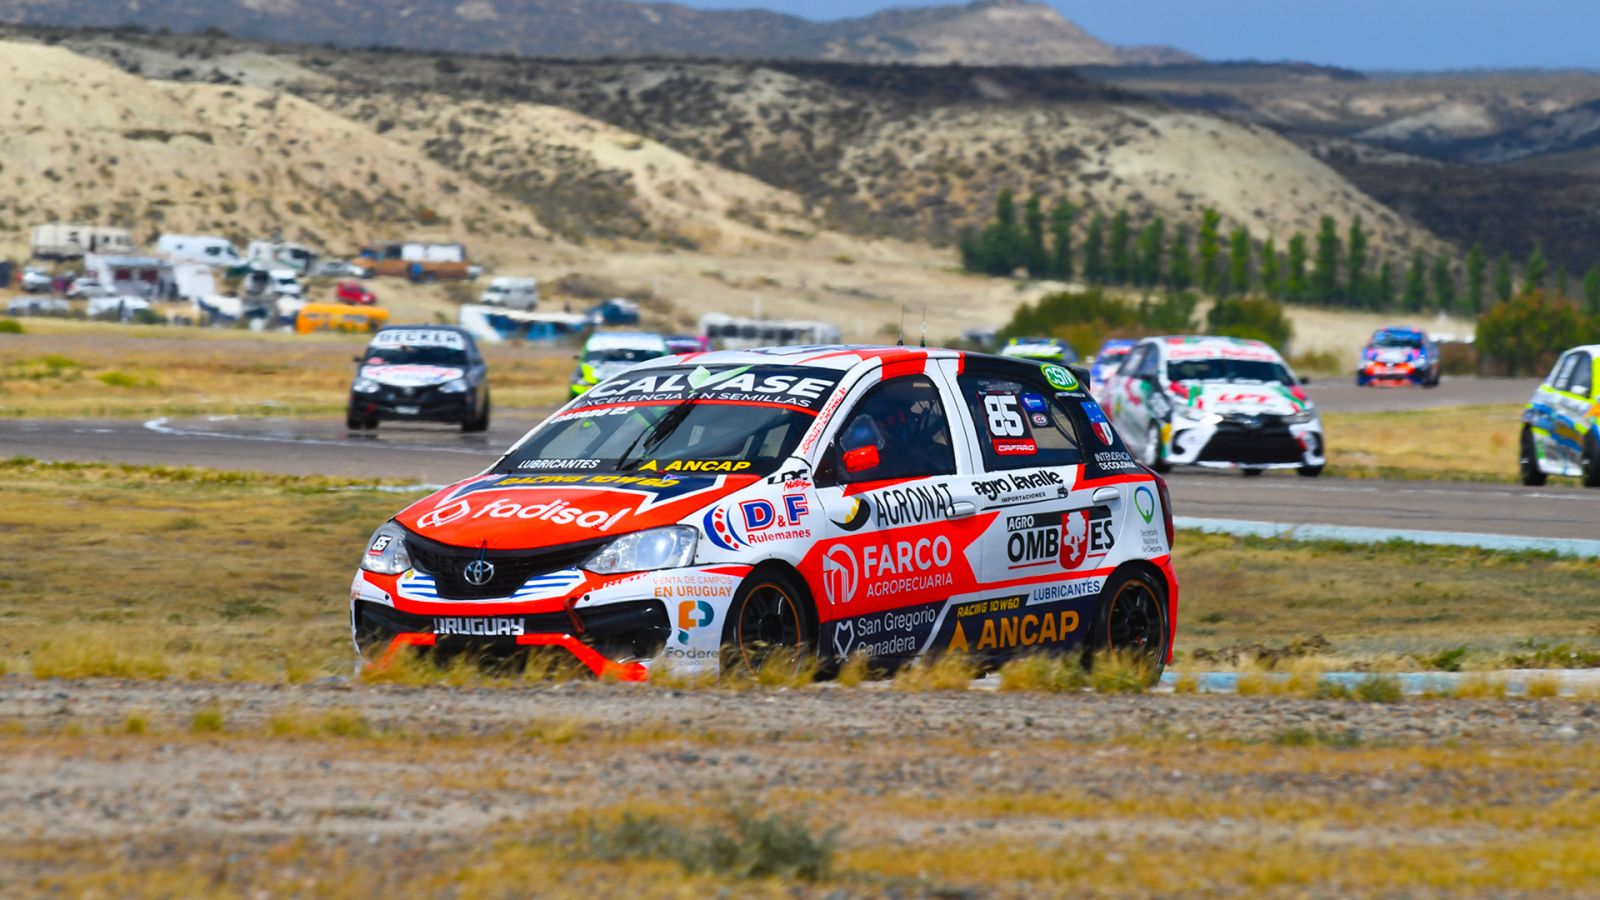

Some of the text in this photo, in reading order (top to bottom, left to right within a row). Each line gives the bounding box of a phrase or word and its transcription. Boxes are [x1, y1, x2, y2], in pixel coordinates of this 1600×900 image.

[588, 365, 834, 399] CALVASE
[1044, 366, 1078, 386] CSM
[719, 392, 811, 408] SEMILLAS
[984, 395, 1025, 437] 85
[518, 459, 601, 469] LUBRICANTES
[664, 460, 751, 473] ANCAP
[971, 470, 1064, 501] agro lavalle
[873, 483, 957, 527] AGRONAT
[1001, 491, 1046, 503] IMPORTACIONES
[472, 498, 632, 531] fadisol
[1007, 515, 1035, 531] AGRO
[747, 528, 811, 544] Rulemanes
[863, 535, 952, 579] FARCO
[684, 576, 697, 584] DE
[698, 576, 733, 584] CAMPOS
[867, 572, 954, 598] AGROPECUARIA
[654, 586, 733, 598] EN URUGUAY
[1033, 581, 1101, 601] LUBRICANTES
[957, 601, 989, 618] RACING
[433, 618, 526, 636] URUGUAY
[857, 605, 937, 637] San Gregorio
[977, 611, 1081, 650] ANCAP
[857, 635, 916, 657] Ganadera
